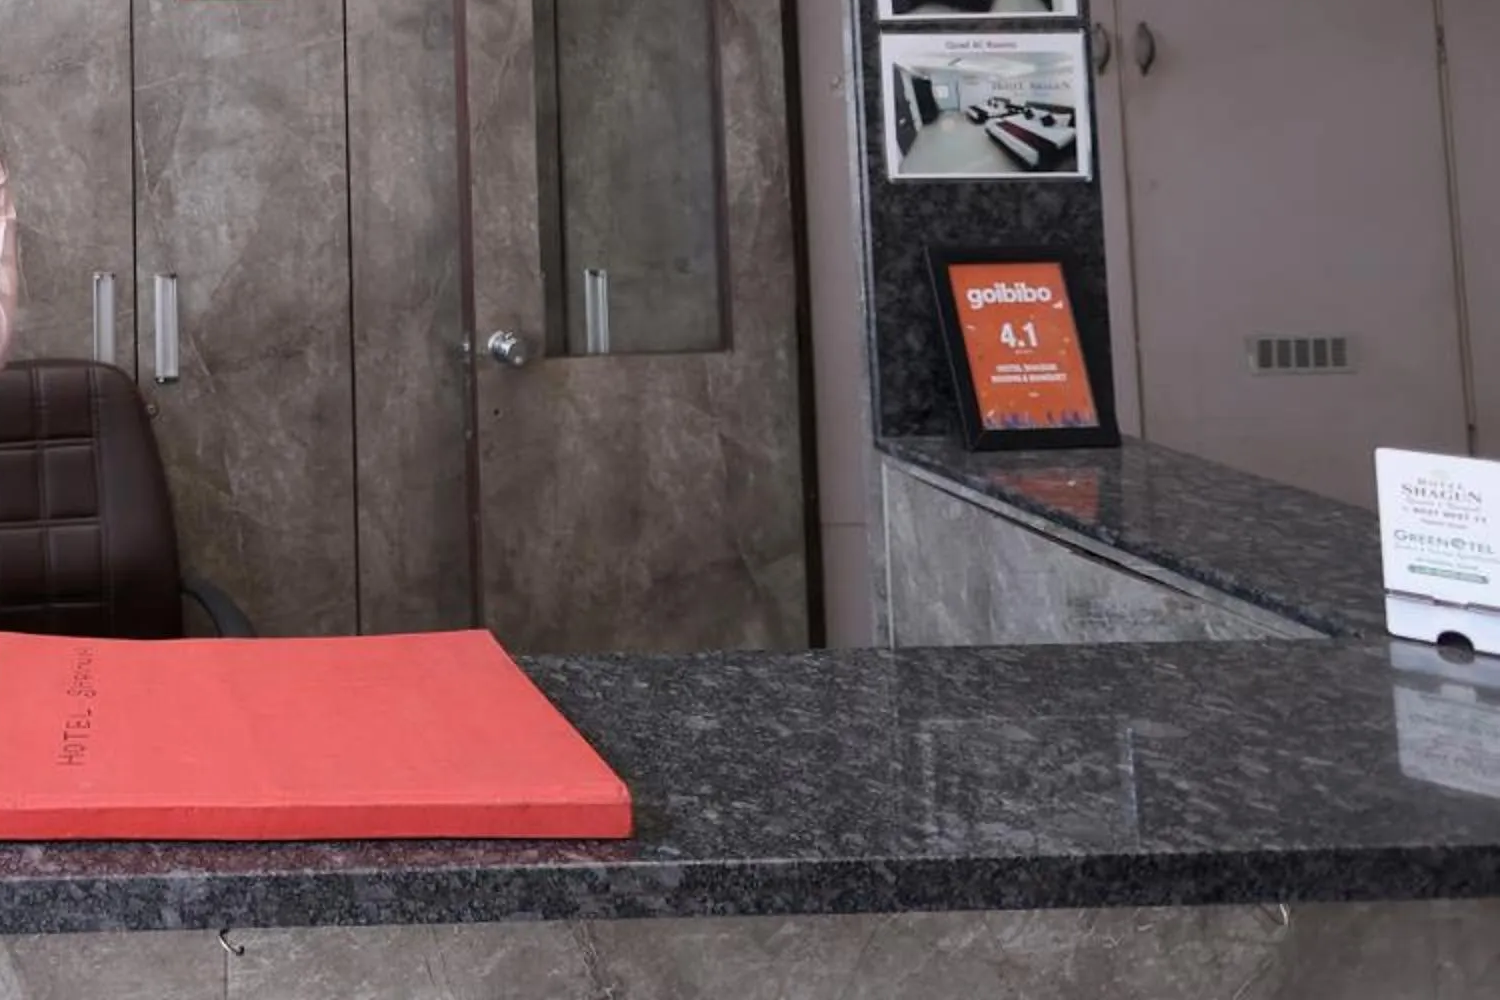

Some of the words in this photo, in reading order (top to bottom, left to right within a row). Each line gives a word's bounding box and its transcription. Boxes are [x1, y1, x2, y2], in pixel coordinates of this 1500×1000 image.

[966, 282, 1052, 310] goibibo
[1000, 322, 1038, 348] 4.1
[1401, 484, 1483, 503] SHAGUN
[56, 707, 92, 766] HOTEL
